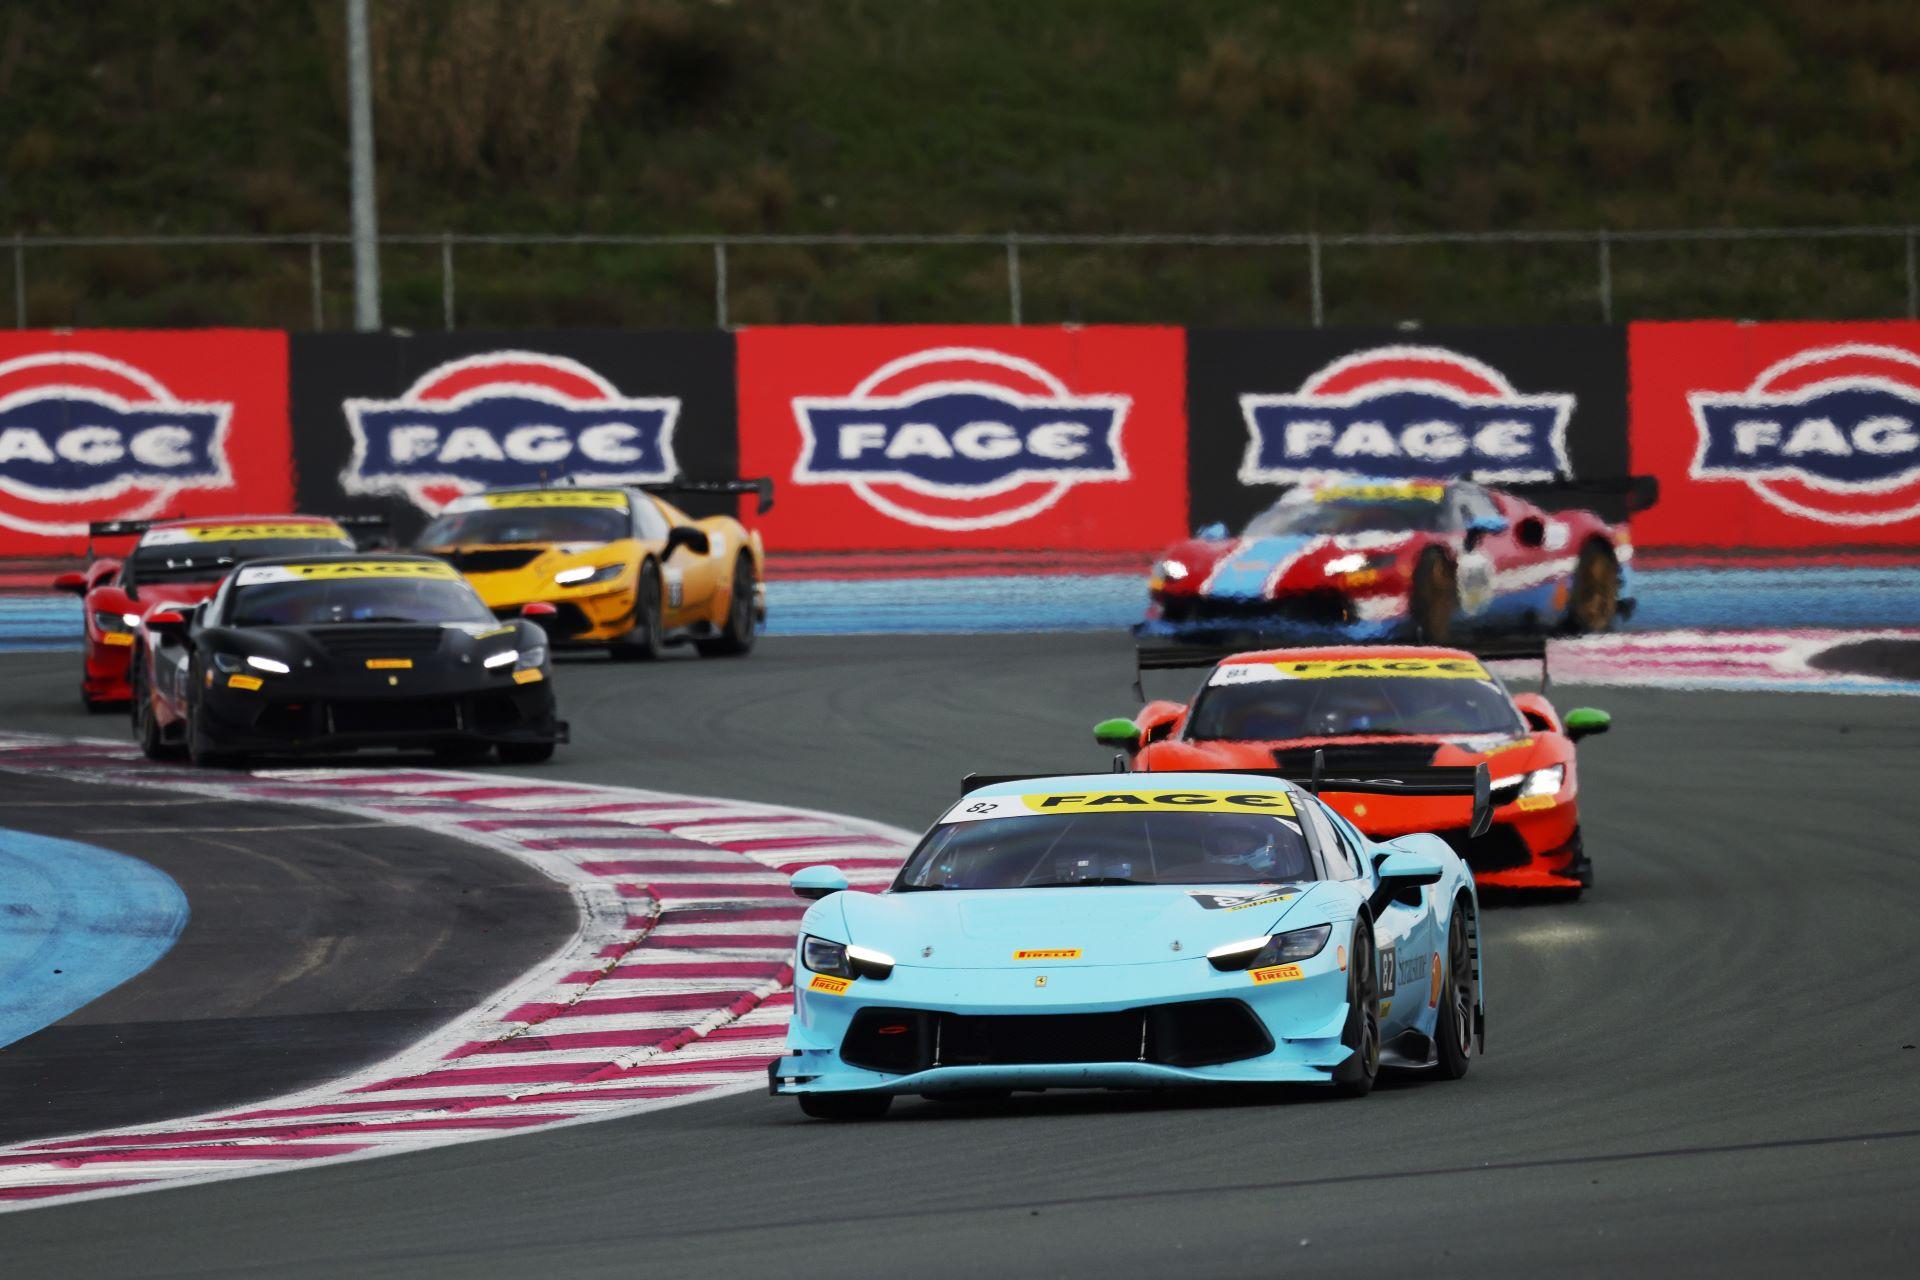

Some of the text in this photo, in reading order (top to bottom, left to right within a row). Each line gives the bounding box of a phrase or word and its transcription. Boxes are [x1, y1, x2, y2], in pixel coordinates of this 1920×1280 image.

[0, 425, 193, 468] AGE
[388, 422, 643, 464] FAGE
[839, 420, 1091, 460] FAGE
[1284, 419, 1535, 462] FAGE
[1733, 414, 1919, 457] FAG
[303, 564, 447, 574] FAGE
[1293, 660, 1476, 673] FAGE
[966, 802, 998, 814] 82
[1040, 793, 1283, 808] FAGE
[811, 976, 849, 992] PIRELLI
[1253, 966, 1300, 982] PIRELLI
[1382, 952, 1394, 992] 82
